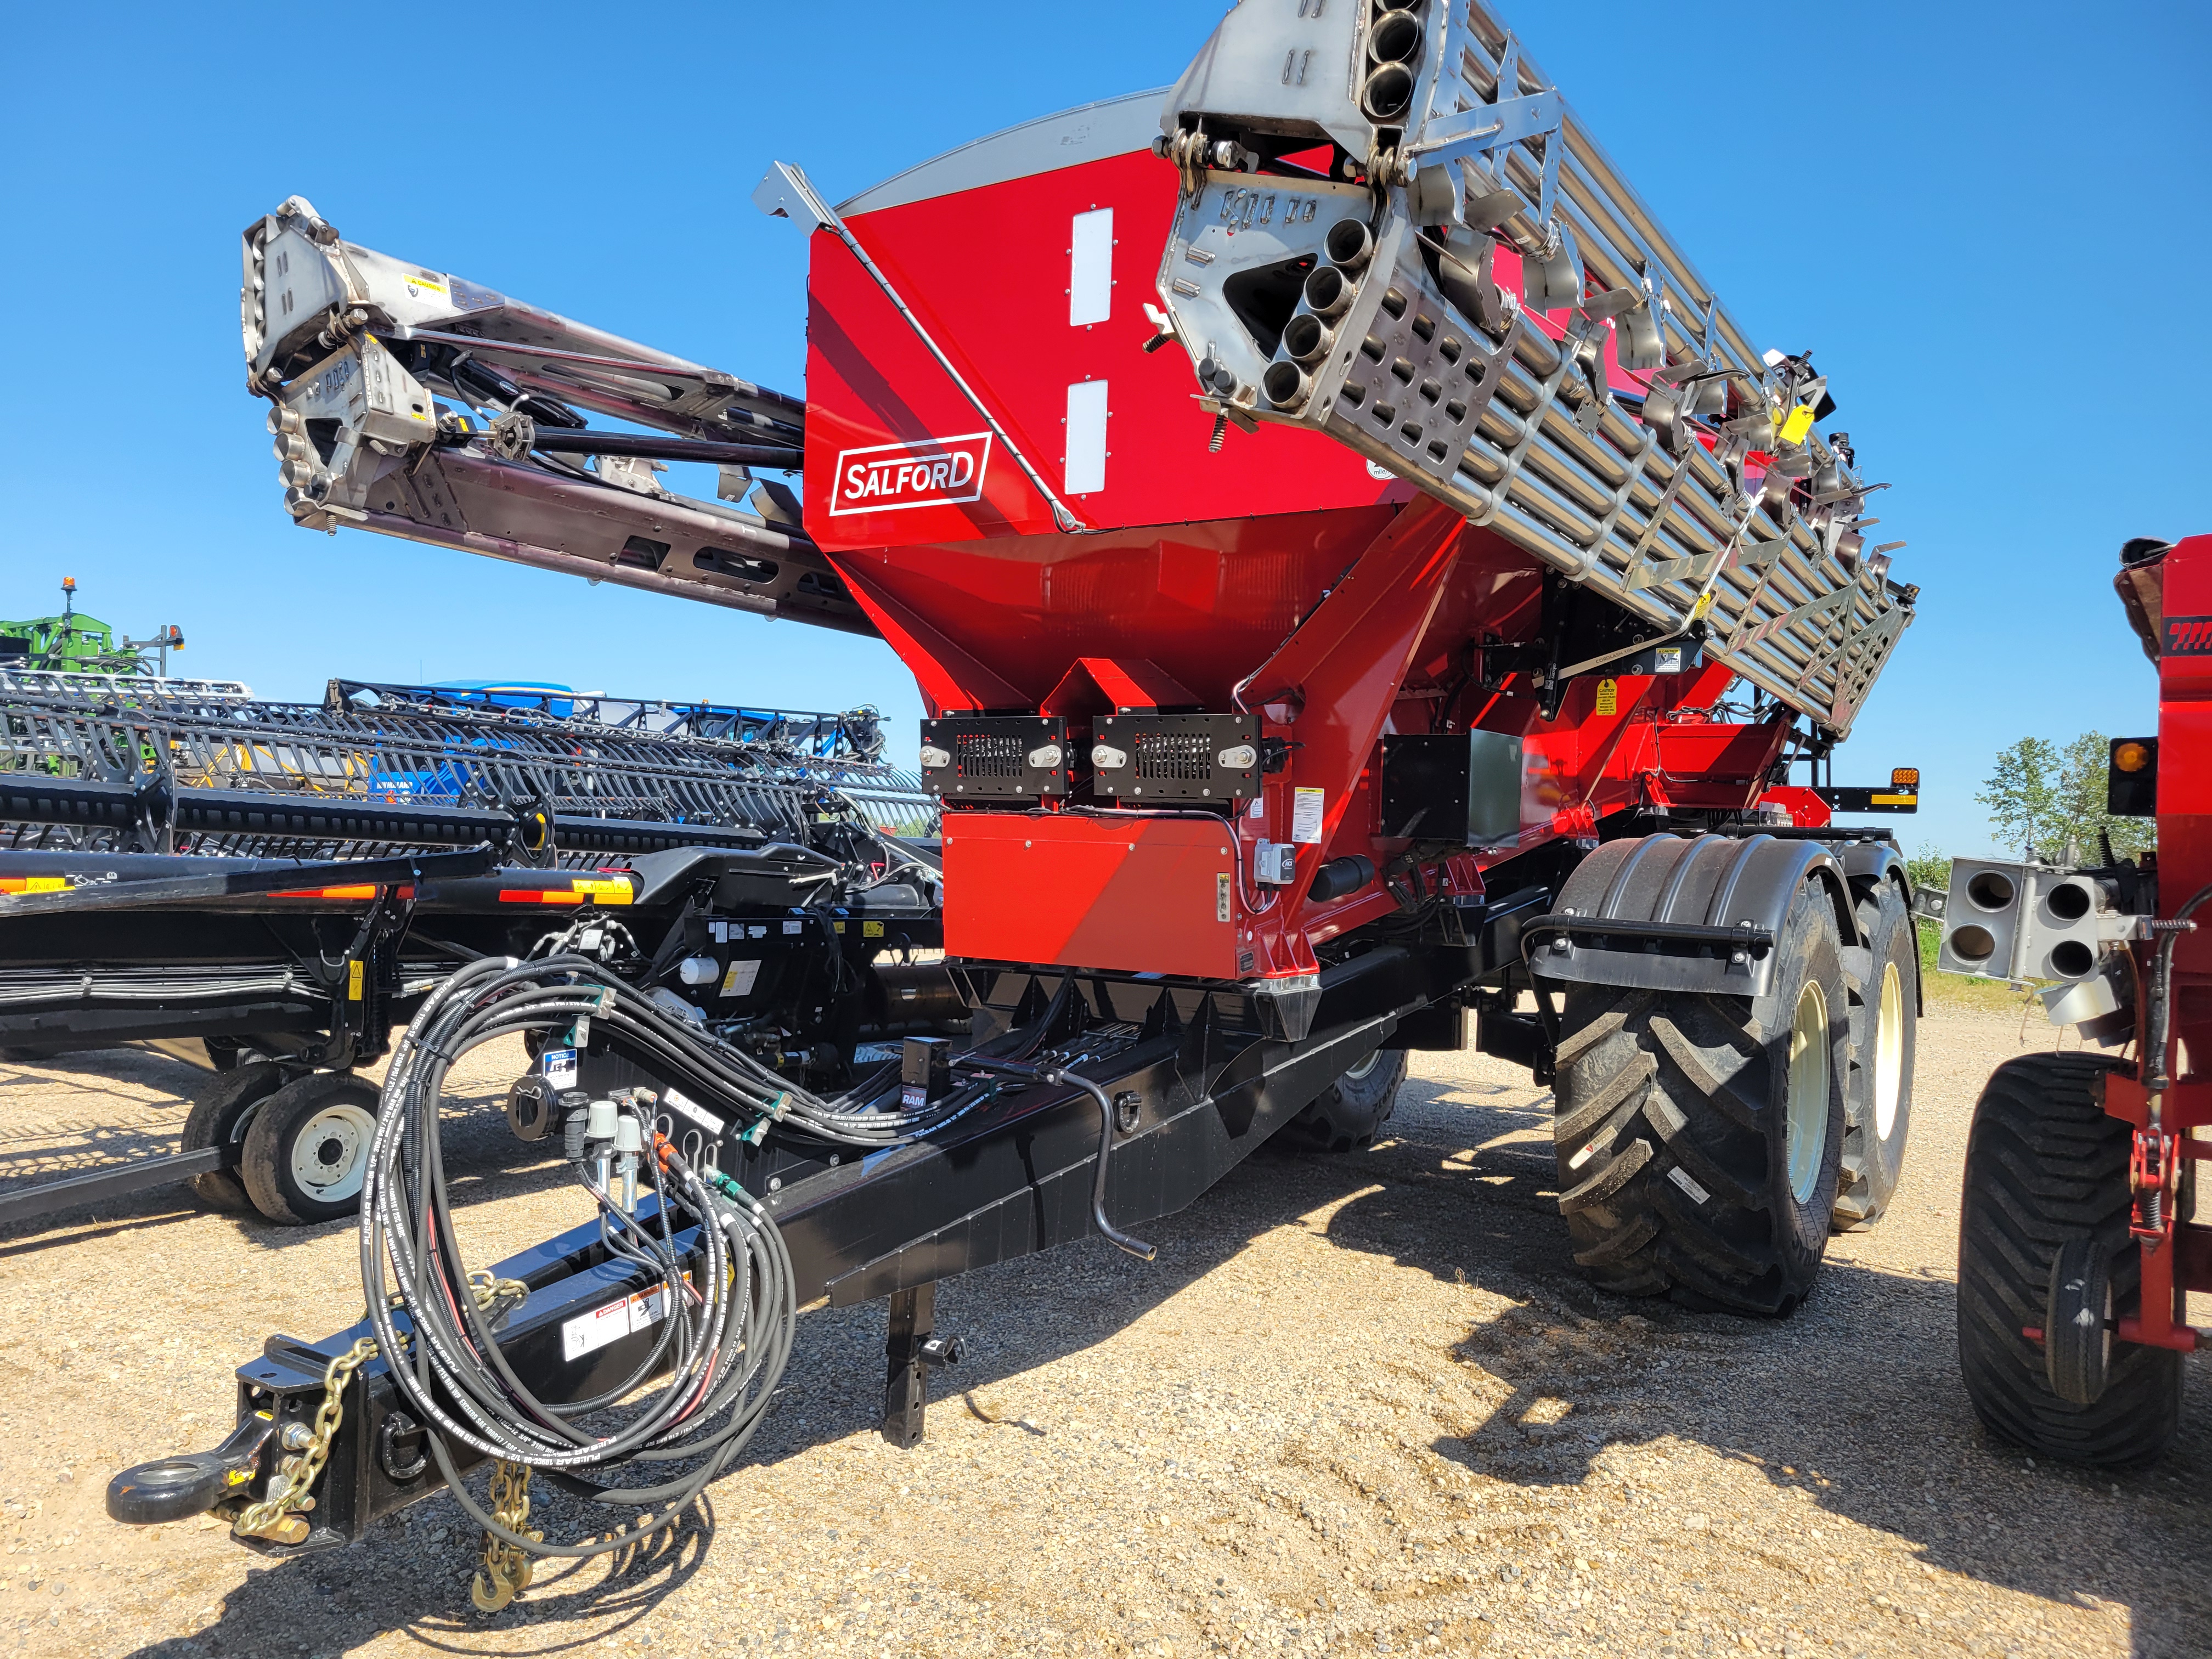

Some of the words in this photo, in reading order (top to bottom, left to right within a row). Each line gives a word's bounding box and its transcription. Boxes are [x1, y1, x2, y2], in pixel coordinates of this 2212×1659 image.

[417, 280, 440, 291] CAUTION
[844, 451, 974, 499] SALFORD
[1595, 652, 1623, 664] CORDLASH
[423, 978, 455, 1012] PULSAR
[408, 1013, 426, 1037] 112CC-12
[395, 1053, 405, 1066] 3100
[391, 1066, 400, 1077] PSI
[902, 1094, 924, 1107] RAM
[915, 1126, 937, 1138] PULSAR
[365, 1171, 375, 1199] 109CC-08
[377, 1126, 386, 1137] PSI
[383, 1111, 391, 1122] 210
[387, 1099, 397, 1111] BAR
[393, 1088, 401, 1099] WP
[385, 1227, 392, 1237] WP
[396, 1223, 405, 1238] HARC
[392, 1251, 400, 1263] 210
[400, 1277, 411, 1293] 3000
[408, 1295, 417, 1307] 1/2"
[603, 1301, 624, 1314] DANGER
[415, 1308, 433, 1335] 109CC-08
[431, 1336, 460, 1373] PULSAR
[408, 1376, 422, 1392] HARC
[417, 1390, 435, 1412] 100R17
[431, 1355, 439, 1366] PSI
[445, 1378, 455, 1390] BAR
[452, 1389, 461, 1399] WP
[459, 1399, 478, 1420] EXCEEDS
[476, 1417, 488, 1429] SAE
[485, 1426, 505, 1442] 100R17
[432, 1408, 444, 1420] SAE
[443, 1419, 455, 1430] WP
[453, 1426, 466, 1437] BAR
[496, 1416, 518, 1436] 112CC-12
[518, 1433, 531, 1443] 3/4"
[531, 1441, 545, 1452] 3100
[464, 1433, 476, 1444] 210
[479, 1442, 490, 1452] PSI
[489, 1446, 506, 1457] 3000
[574, 1436, 617, 1455] PULSAR
[507, 1453, 521, 1462] 1/2"
[524, 1456, 554, 1465] 109CC-08
[556, 1453, 601, 1466] PULSAR
